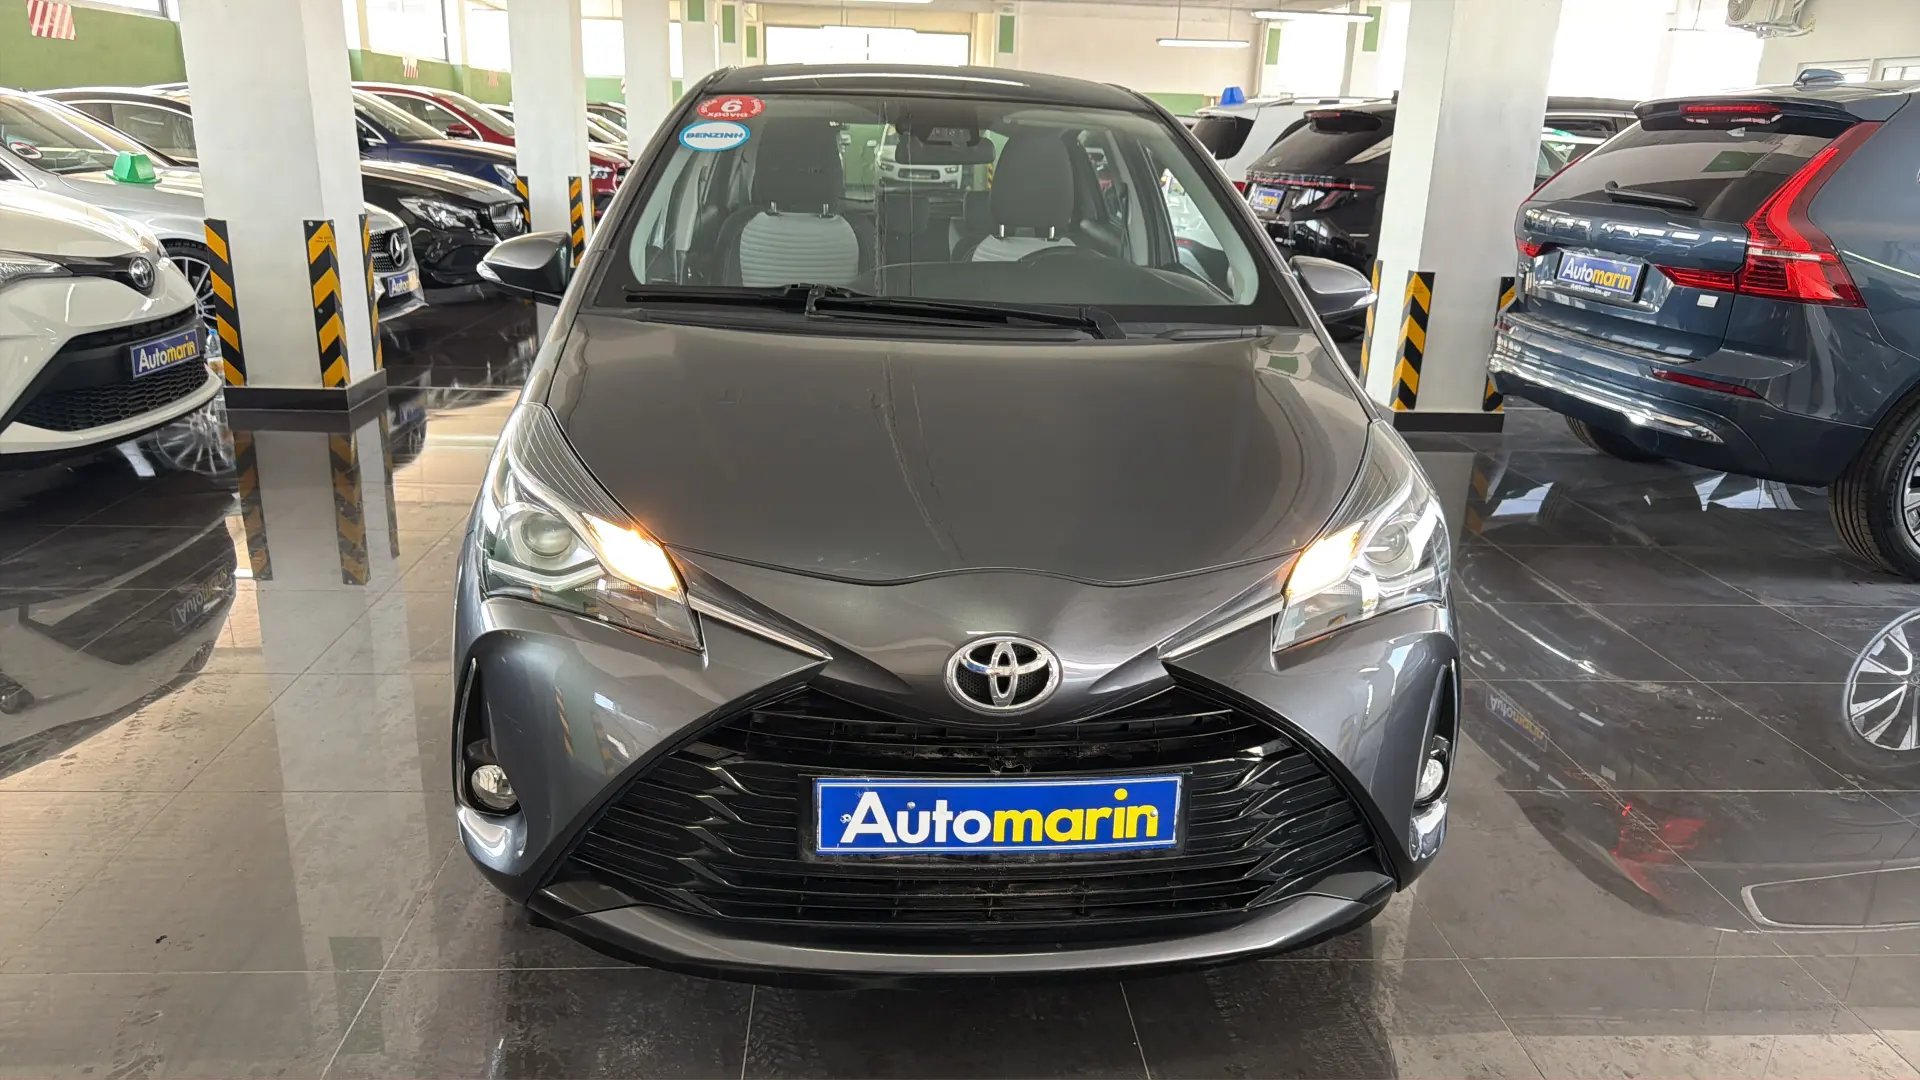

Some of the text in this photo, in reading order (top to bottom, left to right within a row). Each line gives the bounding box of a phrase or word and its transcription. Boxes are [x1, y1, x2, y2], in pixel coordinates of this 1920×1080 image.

[721, 100, 743, 113] 6
[1561, 256, 1632, 291] Automarin
[139, 334, 196, 373] Automarin
[839, 788, 1159, 844] Automarin
